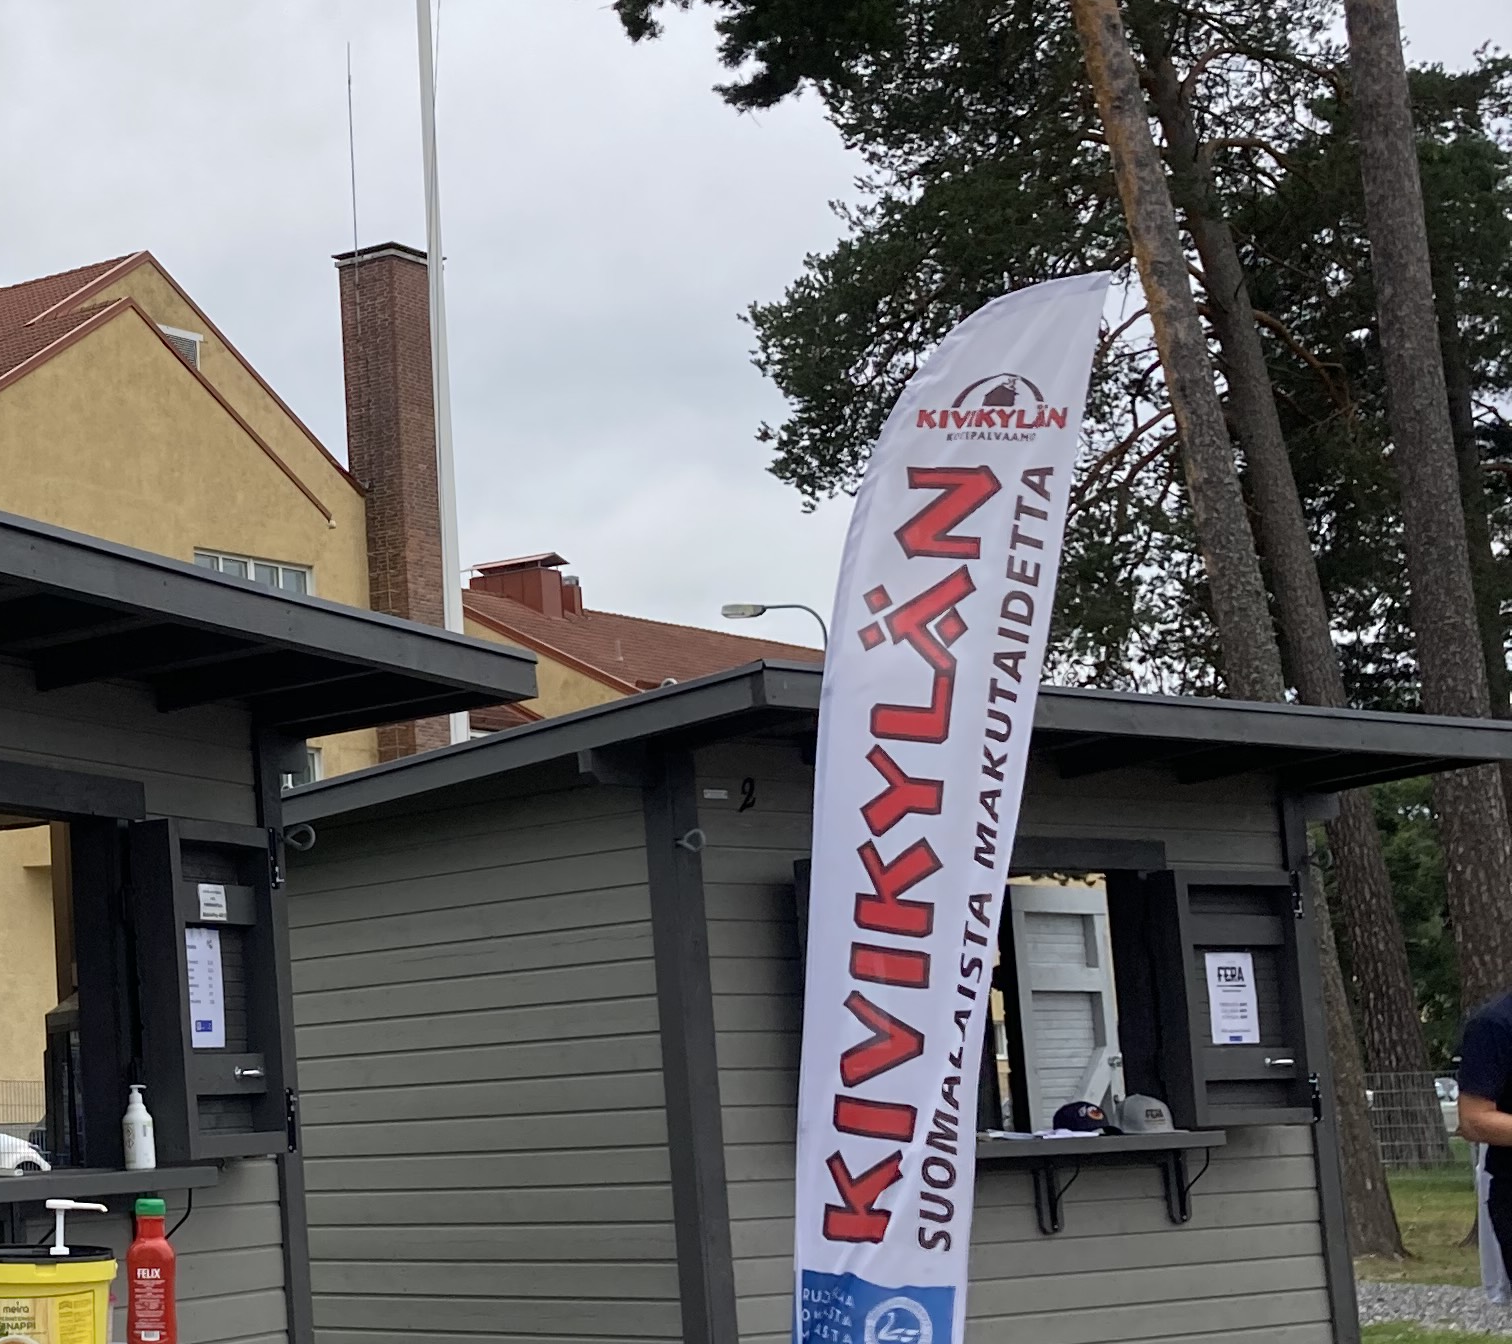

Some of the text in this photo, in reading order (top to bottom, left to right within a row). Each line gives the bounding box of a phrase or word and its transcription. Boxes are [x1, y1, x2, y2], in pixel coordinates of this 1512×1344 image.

[822, 464, 1003, 1245] KIVIKYLÄN
[918, 466, 1055, 1252] SUOMALAISTA MAKUTAIDETTA
[1217, 966, 1245, 982] FERA
[137, 1268, 161, 1279] FELIX
[3, 1301, 30, 1313] meira
